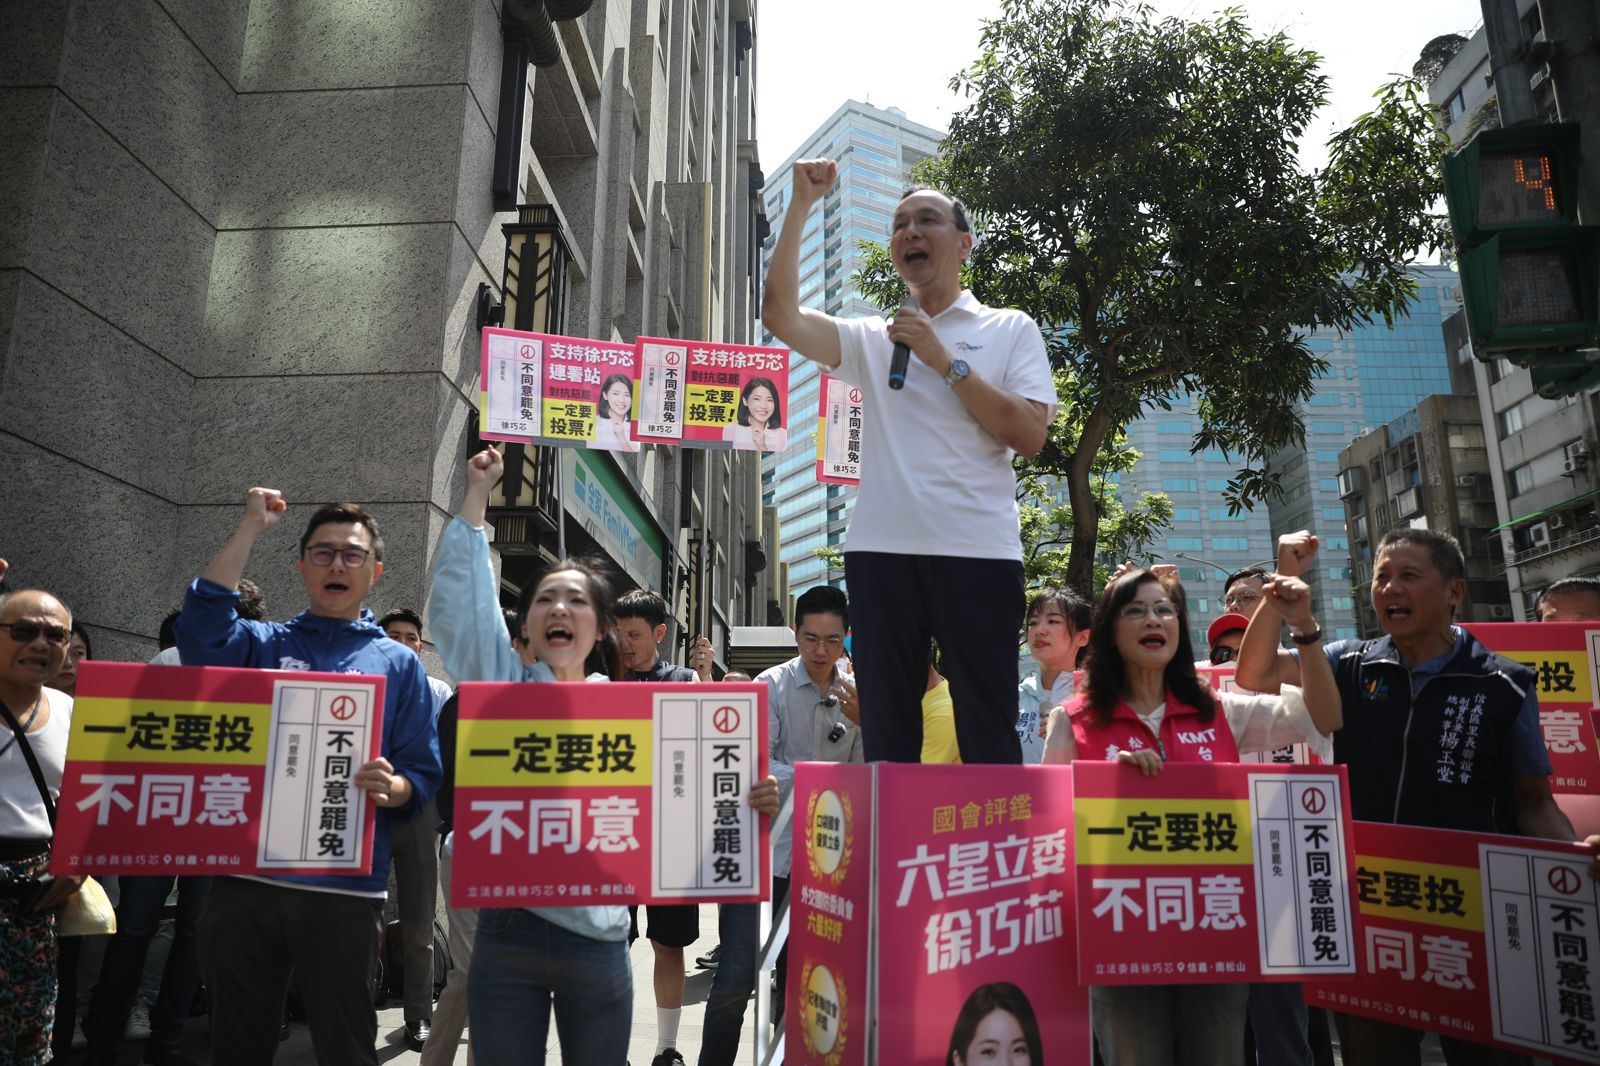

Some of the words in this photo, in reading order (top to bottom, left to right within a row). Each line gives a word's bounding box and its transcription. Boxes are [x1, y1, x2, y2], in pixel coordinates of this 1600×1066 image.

[1514, 156, 1554, 210] 4
[549, 363, 601, 385] 連署站
[550, 342, 635, 367] 支持徐巧芯
[691, 348, 784, 371] 支持徐巧芯
[520, 362, 534, 421] 不同意罷免
[663, 368, 678, 423] 不同意罷免
[690, 389, 735, 404] 一定要
[691, 370, 740, 385] 對抗惡罷
[501, 421, 527, 431] 徐巧芯
[550, 404, 592, 419] 一定要
[550, 417, 594, 436] 投票!
[648, 424, 673, 433] 徐巧芯
[689, 403, 736, 423] 投票!
[847, 406, 862, 464] 不同意罷免
[833, 465, 857, 474] 徐巧芯
[587, 482, 602, 518] 全家
[603, 498, 637, 560] FamilyMart
[83, 711, 255, 754] 一定要投
[469, 732, 637, 774] 一定要投
[1177, 728, 1216, 744] KMT
[285, 733, 301, 778] 同意罷免
[672, 750, 685, 798] 同意罷免
[1436, 731, 1460, 784] 楊玉堂
[76, 773, 251, 826] 不同意
[316, 730, 354, 857] 不同意罷免
[712, 744, 742, 883] 不同意罷免
[932, 793, 1032, 835] 國會評鑑
[469, 795, 640, 855] 不同意
[1087, 811, 1239, 852] 一定要投
[68, 854, 162, 867] 立法委員徐巧芯
[896, 828, 1066, 908] 六星立委
[1269, 829, 1283, 877] 同意罷免
[467, 885, 554, 898] 立法委員徐巧芯
[1092, 874, 1247, 932] 不同意
[1303, 824, 1340, 962] 不同意罷免
[924, 889, 1064, 975] 徐巧芯
[1504, 902, 1522, 951] 同意罷免
[1095, 962, 1174, 975] 立法委員徐巧芯
[1364, 926, 1476, 990] 同意
[1549, 903, 1599, 1052] 不同意罷免
